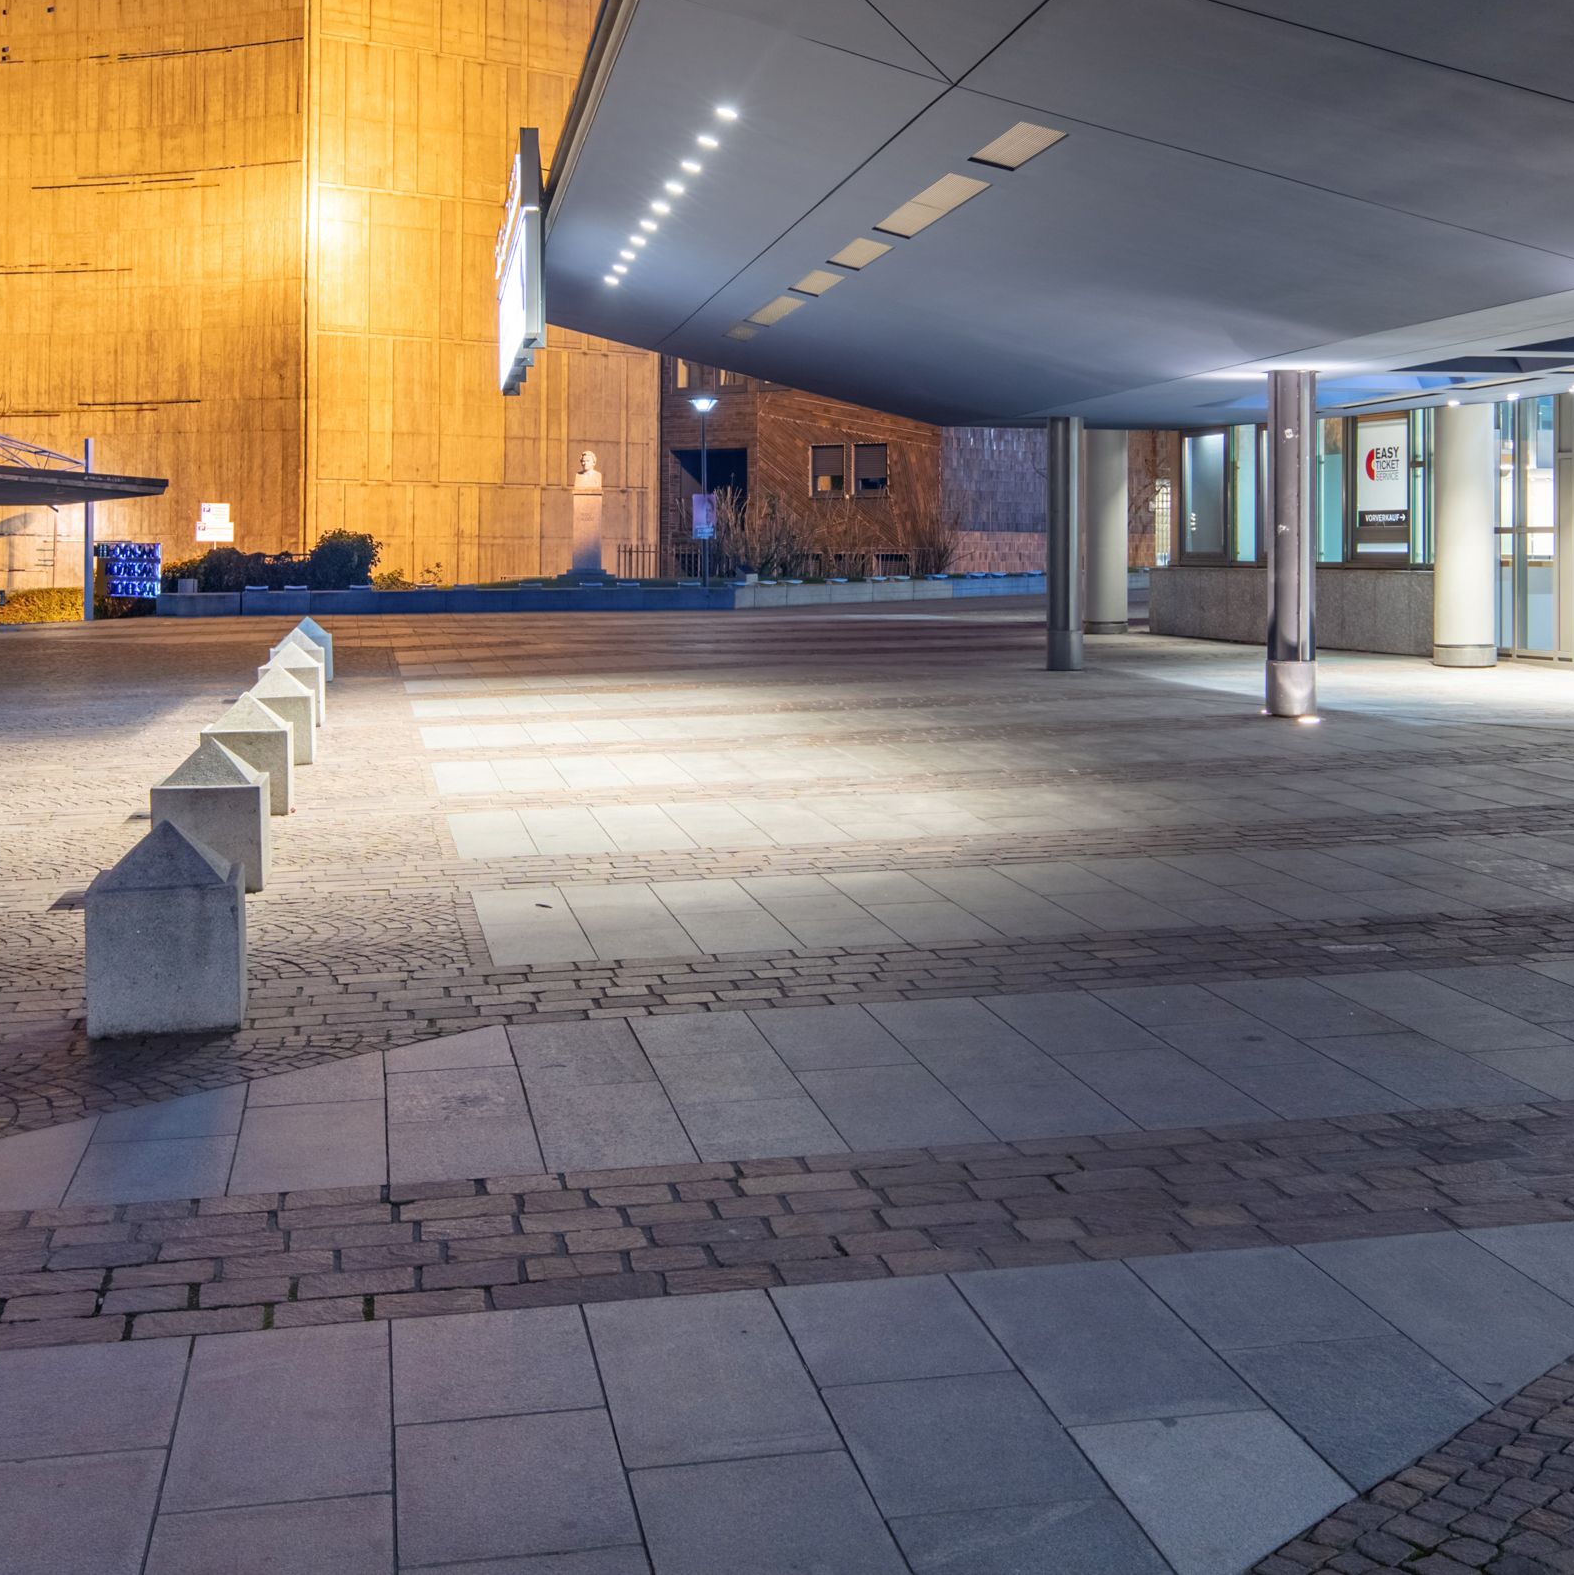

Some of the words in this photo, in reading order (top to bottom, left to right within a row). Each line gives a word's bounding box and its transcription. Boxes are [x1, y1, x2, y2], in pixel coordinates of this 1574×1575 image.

[1375, 447, 1399, 459] EASY
[1376, 459, 1399, 470] TICKET
[1376, 472, 1399, 481] SERVICE
[1365, 513, 1400, 522] VORVERKAUF
